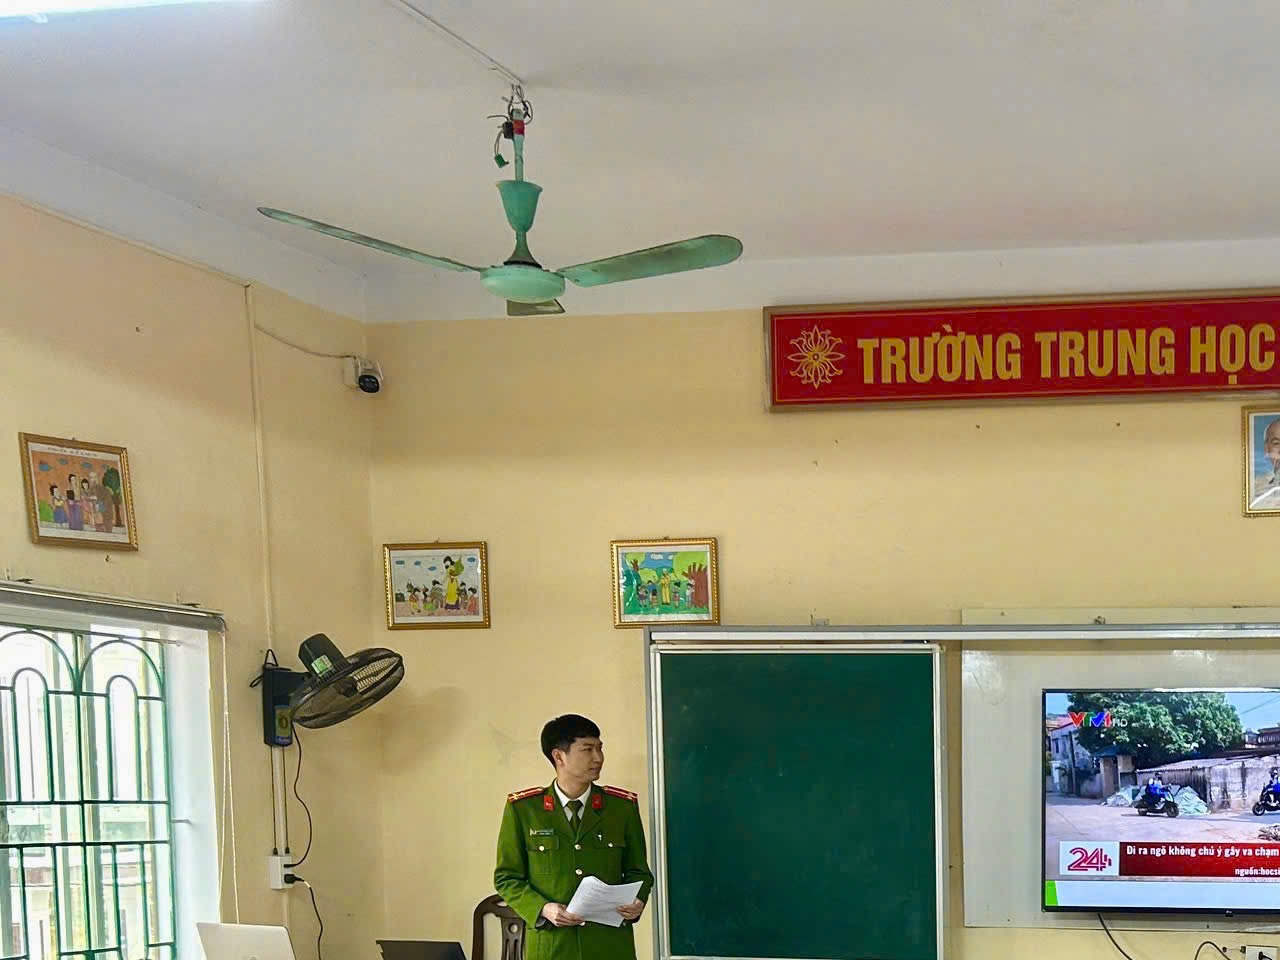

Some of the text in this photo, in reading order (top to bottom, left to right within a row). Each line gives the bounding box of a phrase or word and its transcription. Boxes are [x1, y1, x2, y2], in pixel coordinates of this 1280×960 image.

[857, 323, 1022, 385] TRƯỜNG
[1034, 327, 1176, 379] TRUNG
[1189, 323, 1276, 385] HỌC
[1112, 718, 1128, 728] HD
[1139, 847, 1148, 855] ra
[1150, 845, 1166, 857] ngõ
[1168, 845, 1195, 857] không
[1198, 846, 1214, 856] chú
[1216, 846, 1222, 857] ý
[1224, 846, 1240, 857] gây
[1242, 848, 1253, 856] va
[1255, 846, 1279, 858] chạm
